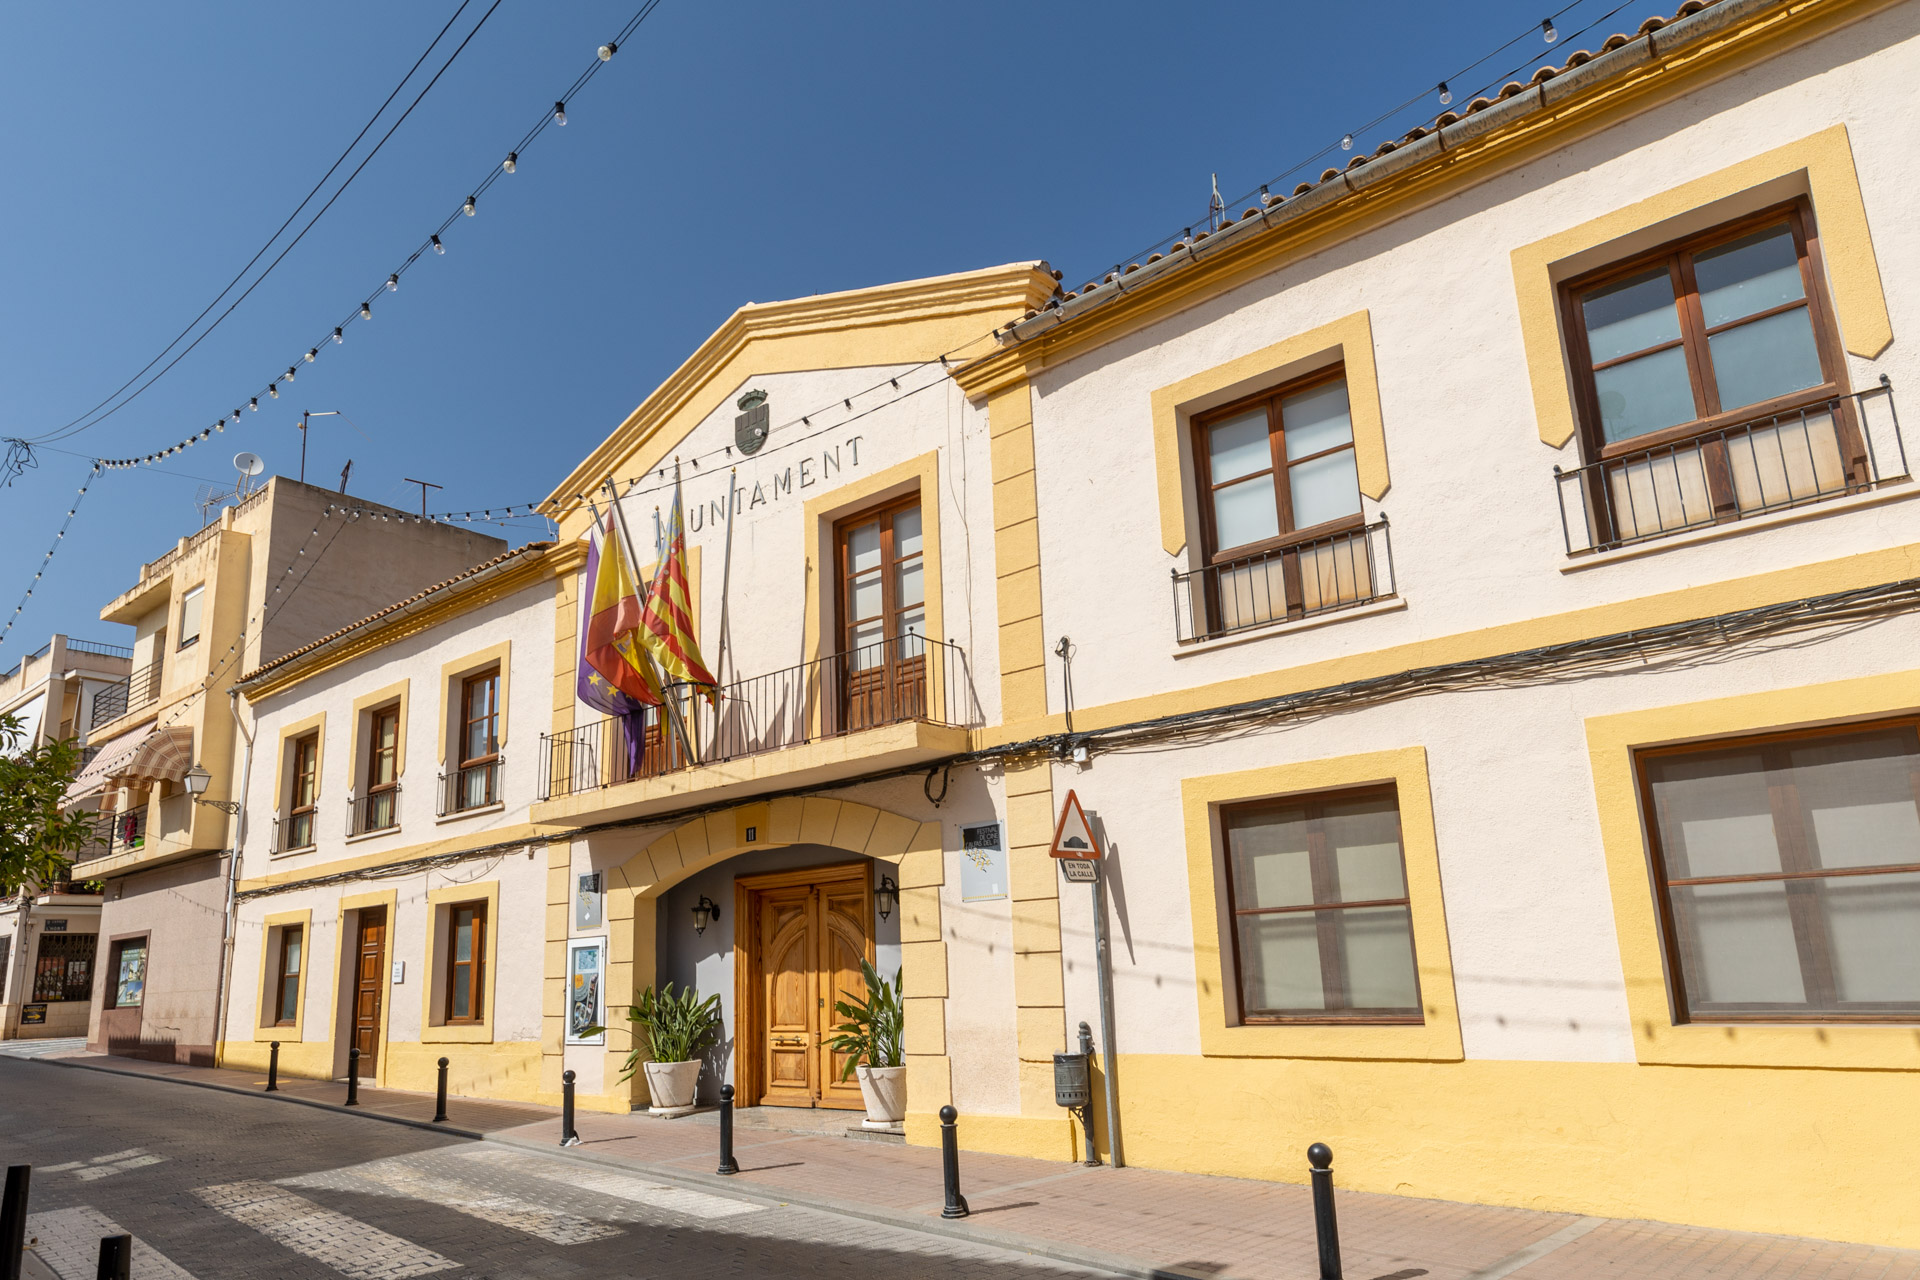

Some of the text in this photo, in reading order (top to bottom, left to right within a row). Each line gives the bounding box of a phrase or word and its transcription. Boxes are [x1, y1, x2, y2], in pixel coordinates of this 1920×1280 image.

[652, 435, 863, 547] UNTAMENT
[977, 826, 998, 835] FESTIVAL
[1076, 862, 1091, 870] TODA
[1077, 870, 1094, 878] CALLE
